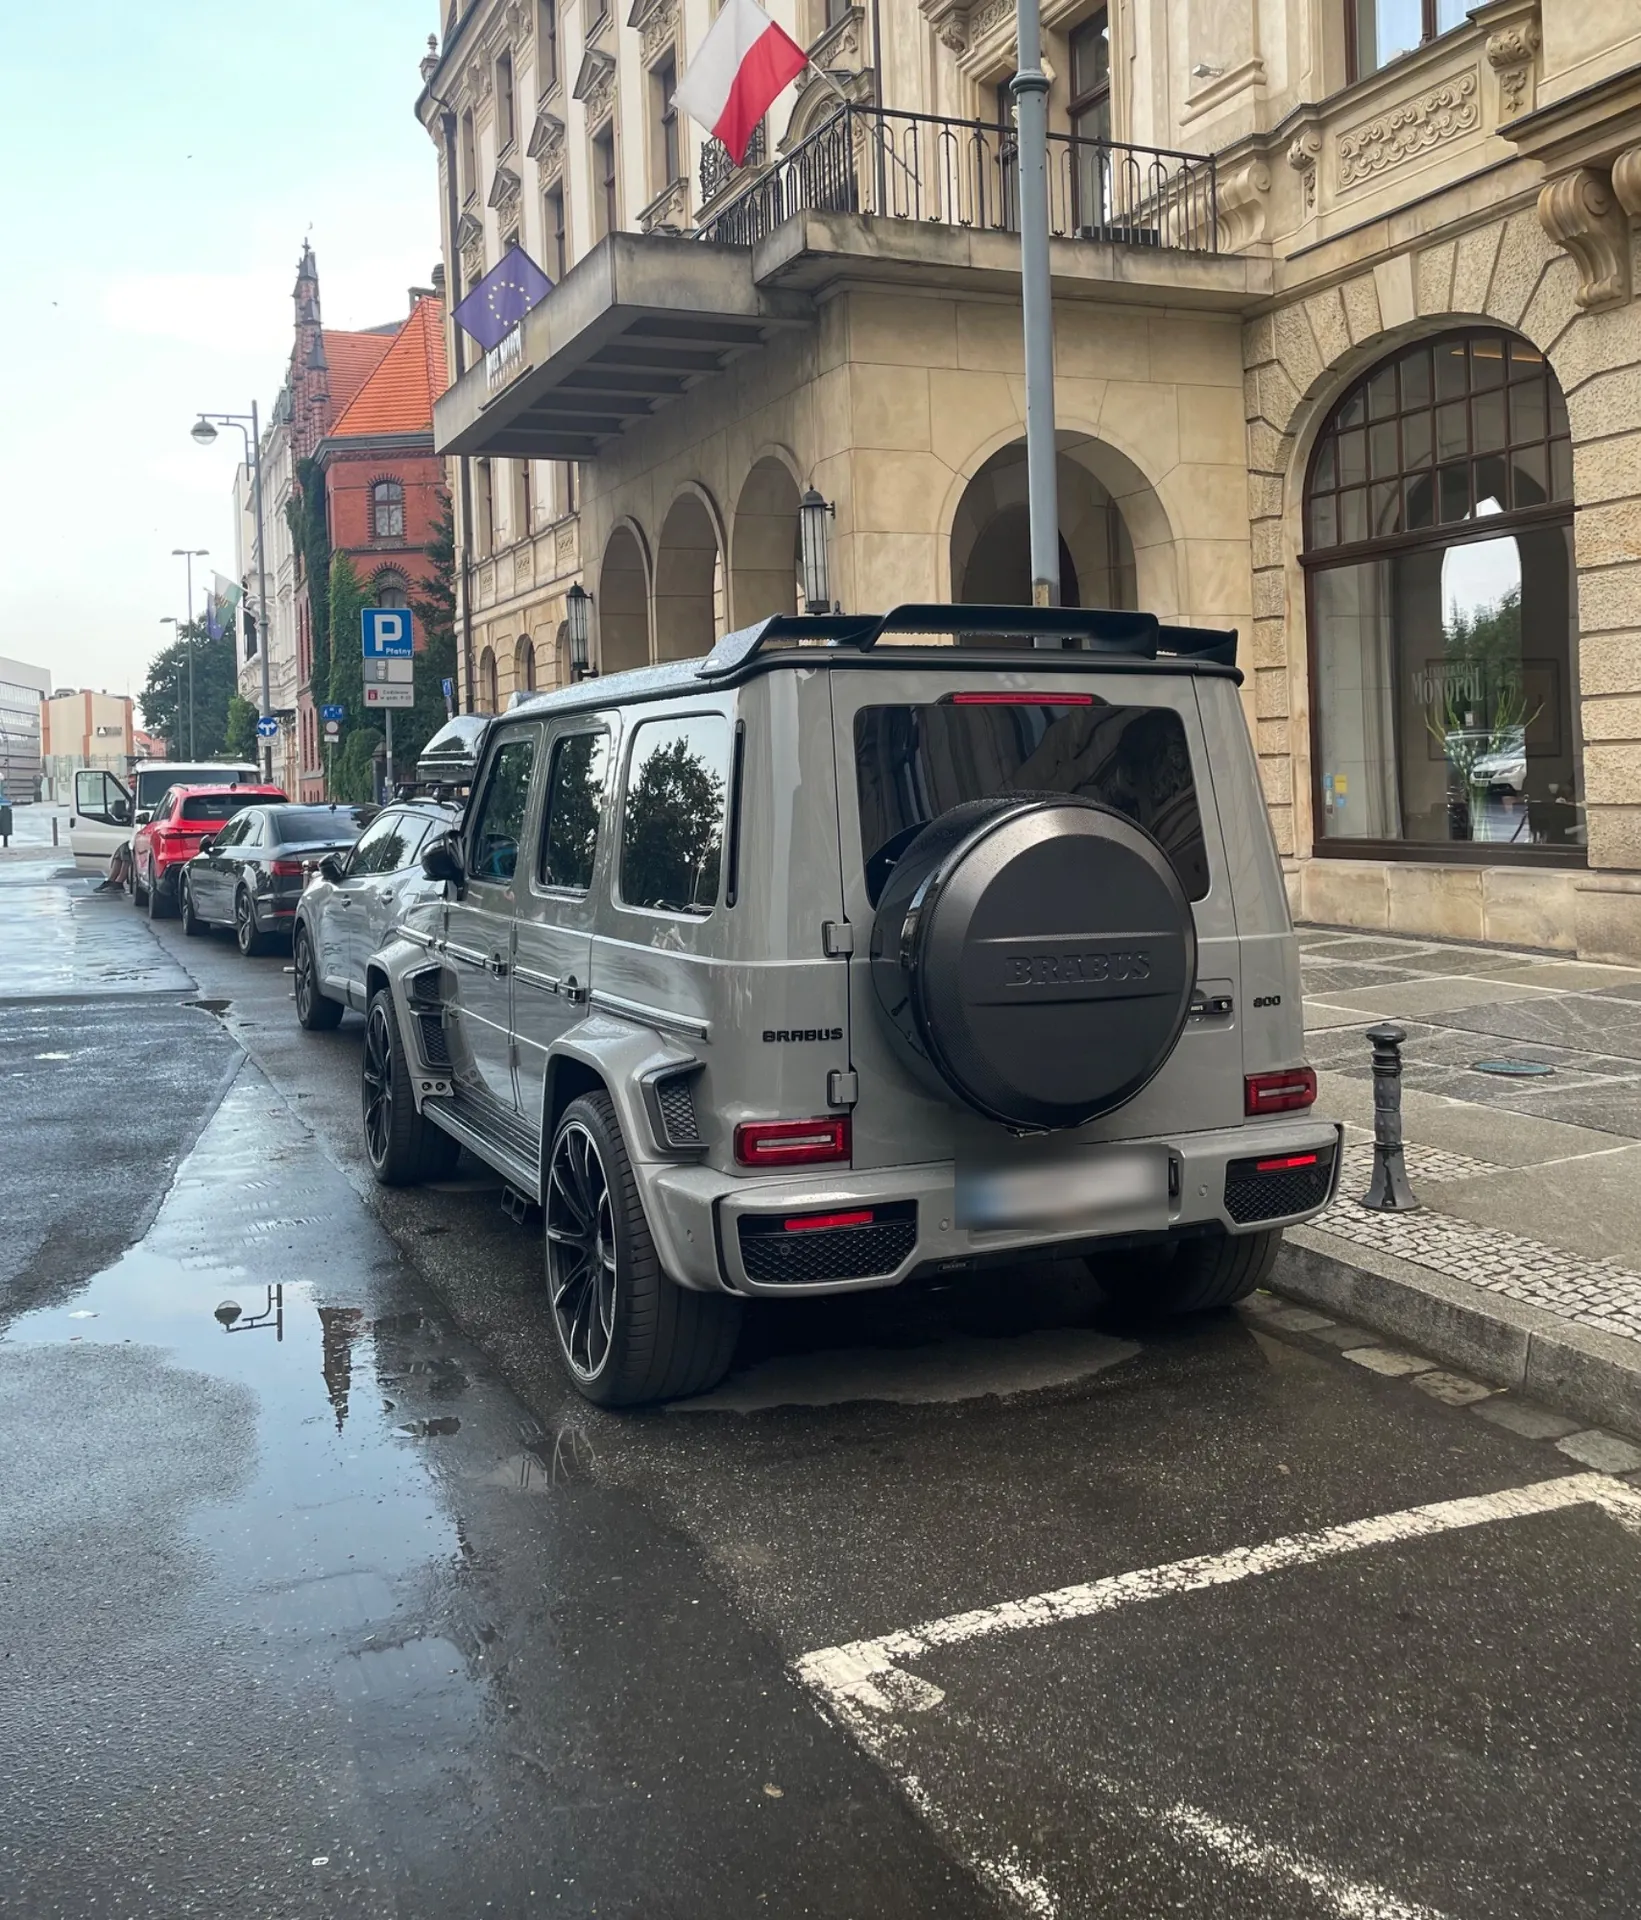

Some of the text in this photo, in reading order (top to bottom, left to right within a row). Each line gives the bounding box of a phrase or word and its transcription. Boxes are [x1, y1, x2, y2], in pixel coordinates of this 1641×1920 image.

[374, 614, 402, 651] P
[1411, 667, 1484, 704] MONOPOL
[1005, 952, 1150, 986] BRABUS
[1253, 996, 1281, 1008] 800
[762, 1028, 843, 1042] BRABUS
